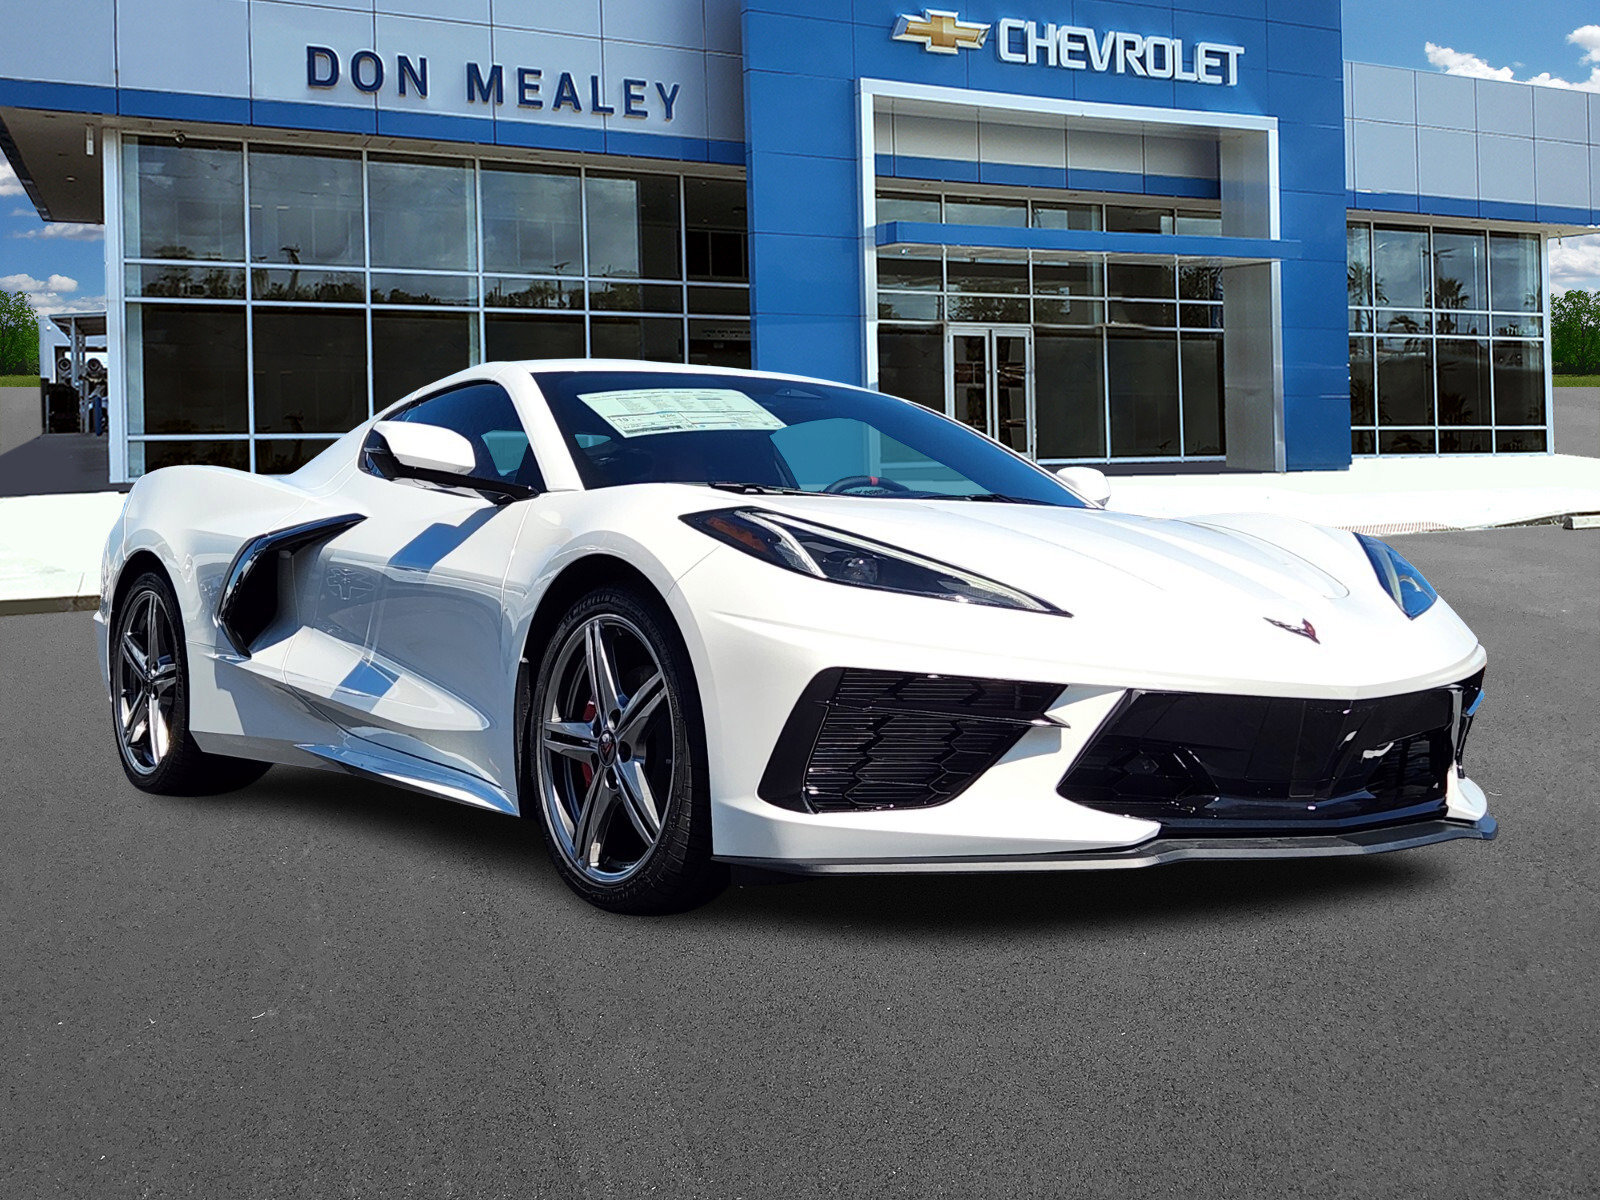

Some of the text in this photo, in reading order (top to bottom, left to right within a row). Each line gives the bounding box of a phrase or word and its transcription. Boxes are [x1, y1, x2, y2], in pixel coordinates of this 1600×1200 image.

[306, 45, 681, 122] DON MEALEY
[998, 17, 1245, 87] CHEVROLET
